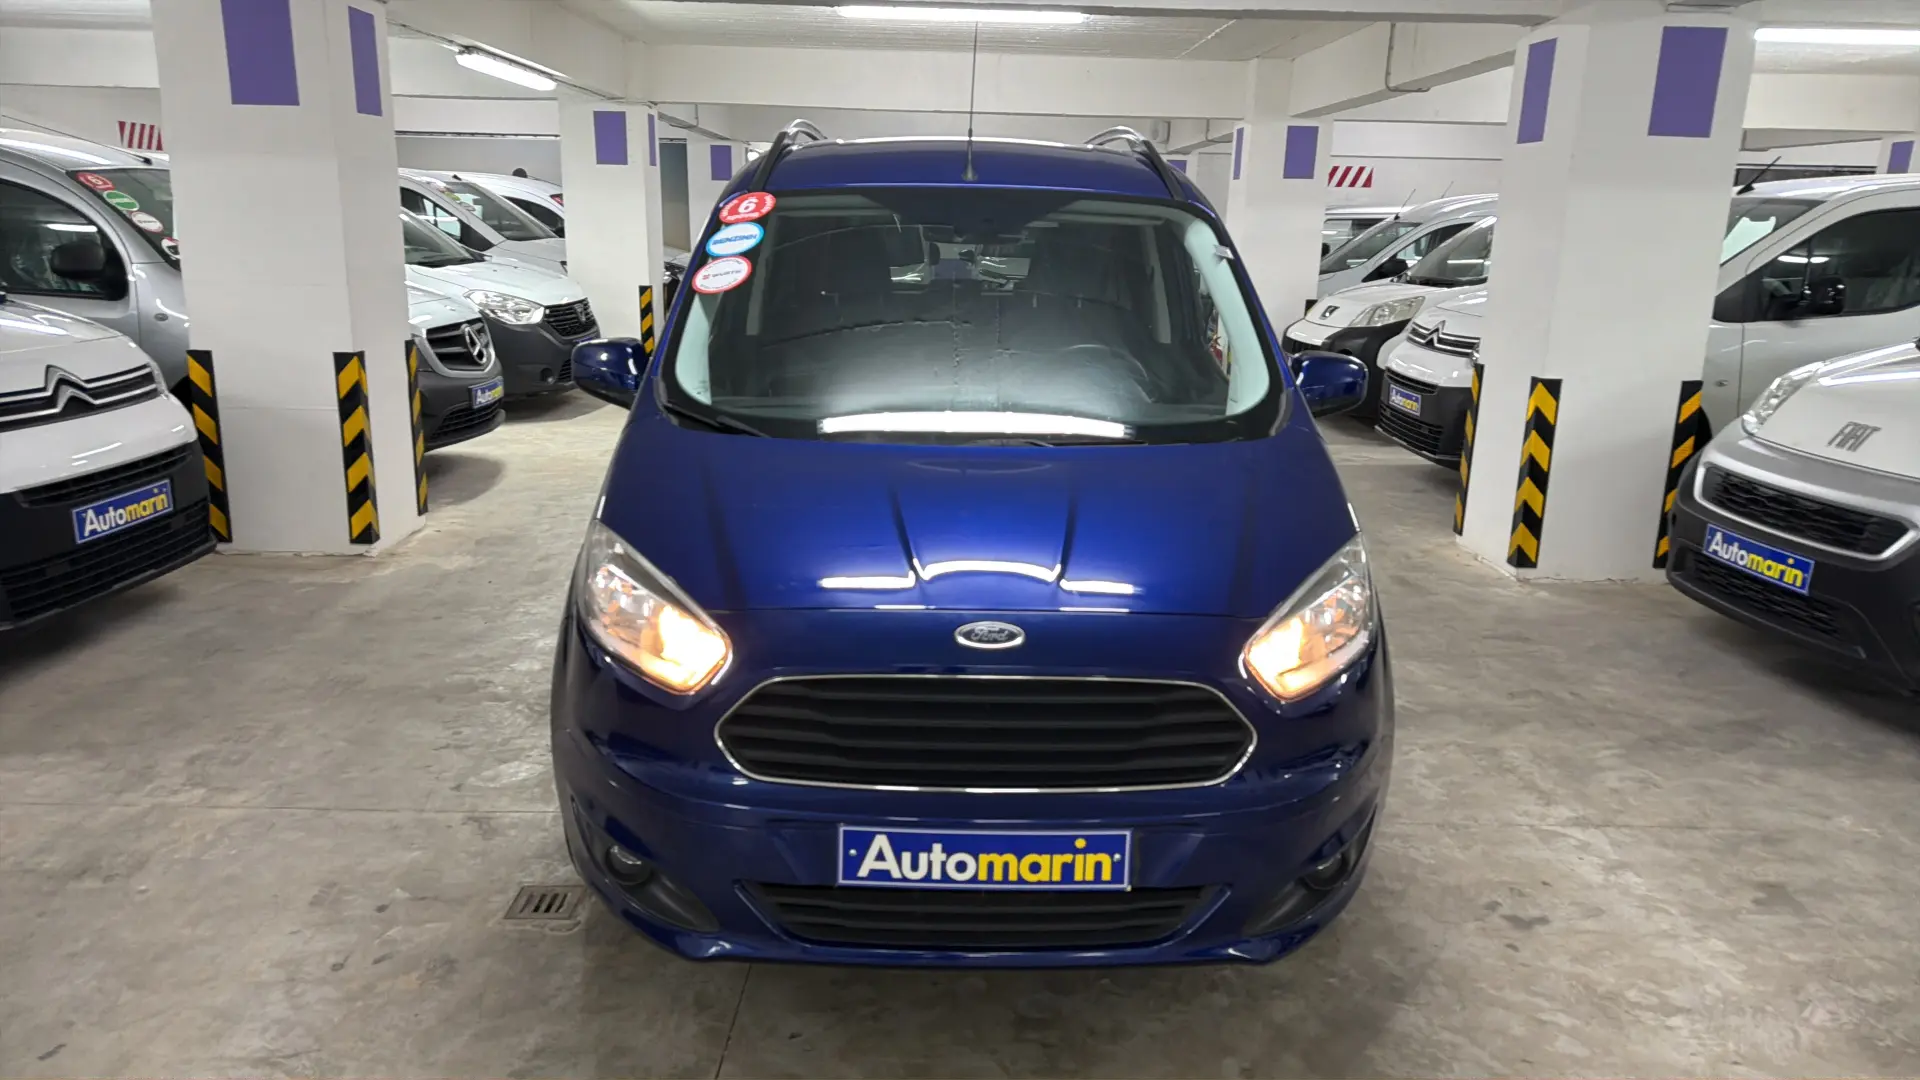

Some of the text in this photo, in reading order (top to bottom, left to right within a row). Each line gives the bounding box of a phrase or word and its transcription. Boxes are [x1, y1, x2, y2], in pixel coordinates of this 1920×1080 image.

[737, 198, 759, 214] 6
[1827, 421, 1882, 452] FIAT
[84, 487, 168, 537] Automarin
[1703, 531, 1804, 587] Automarin
[971, 626, 1009, 641] Ford
[857, 834, 1112, 882] Automarin
